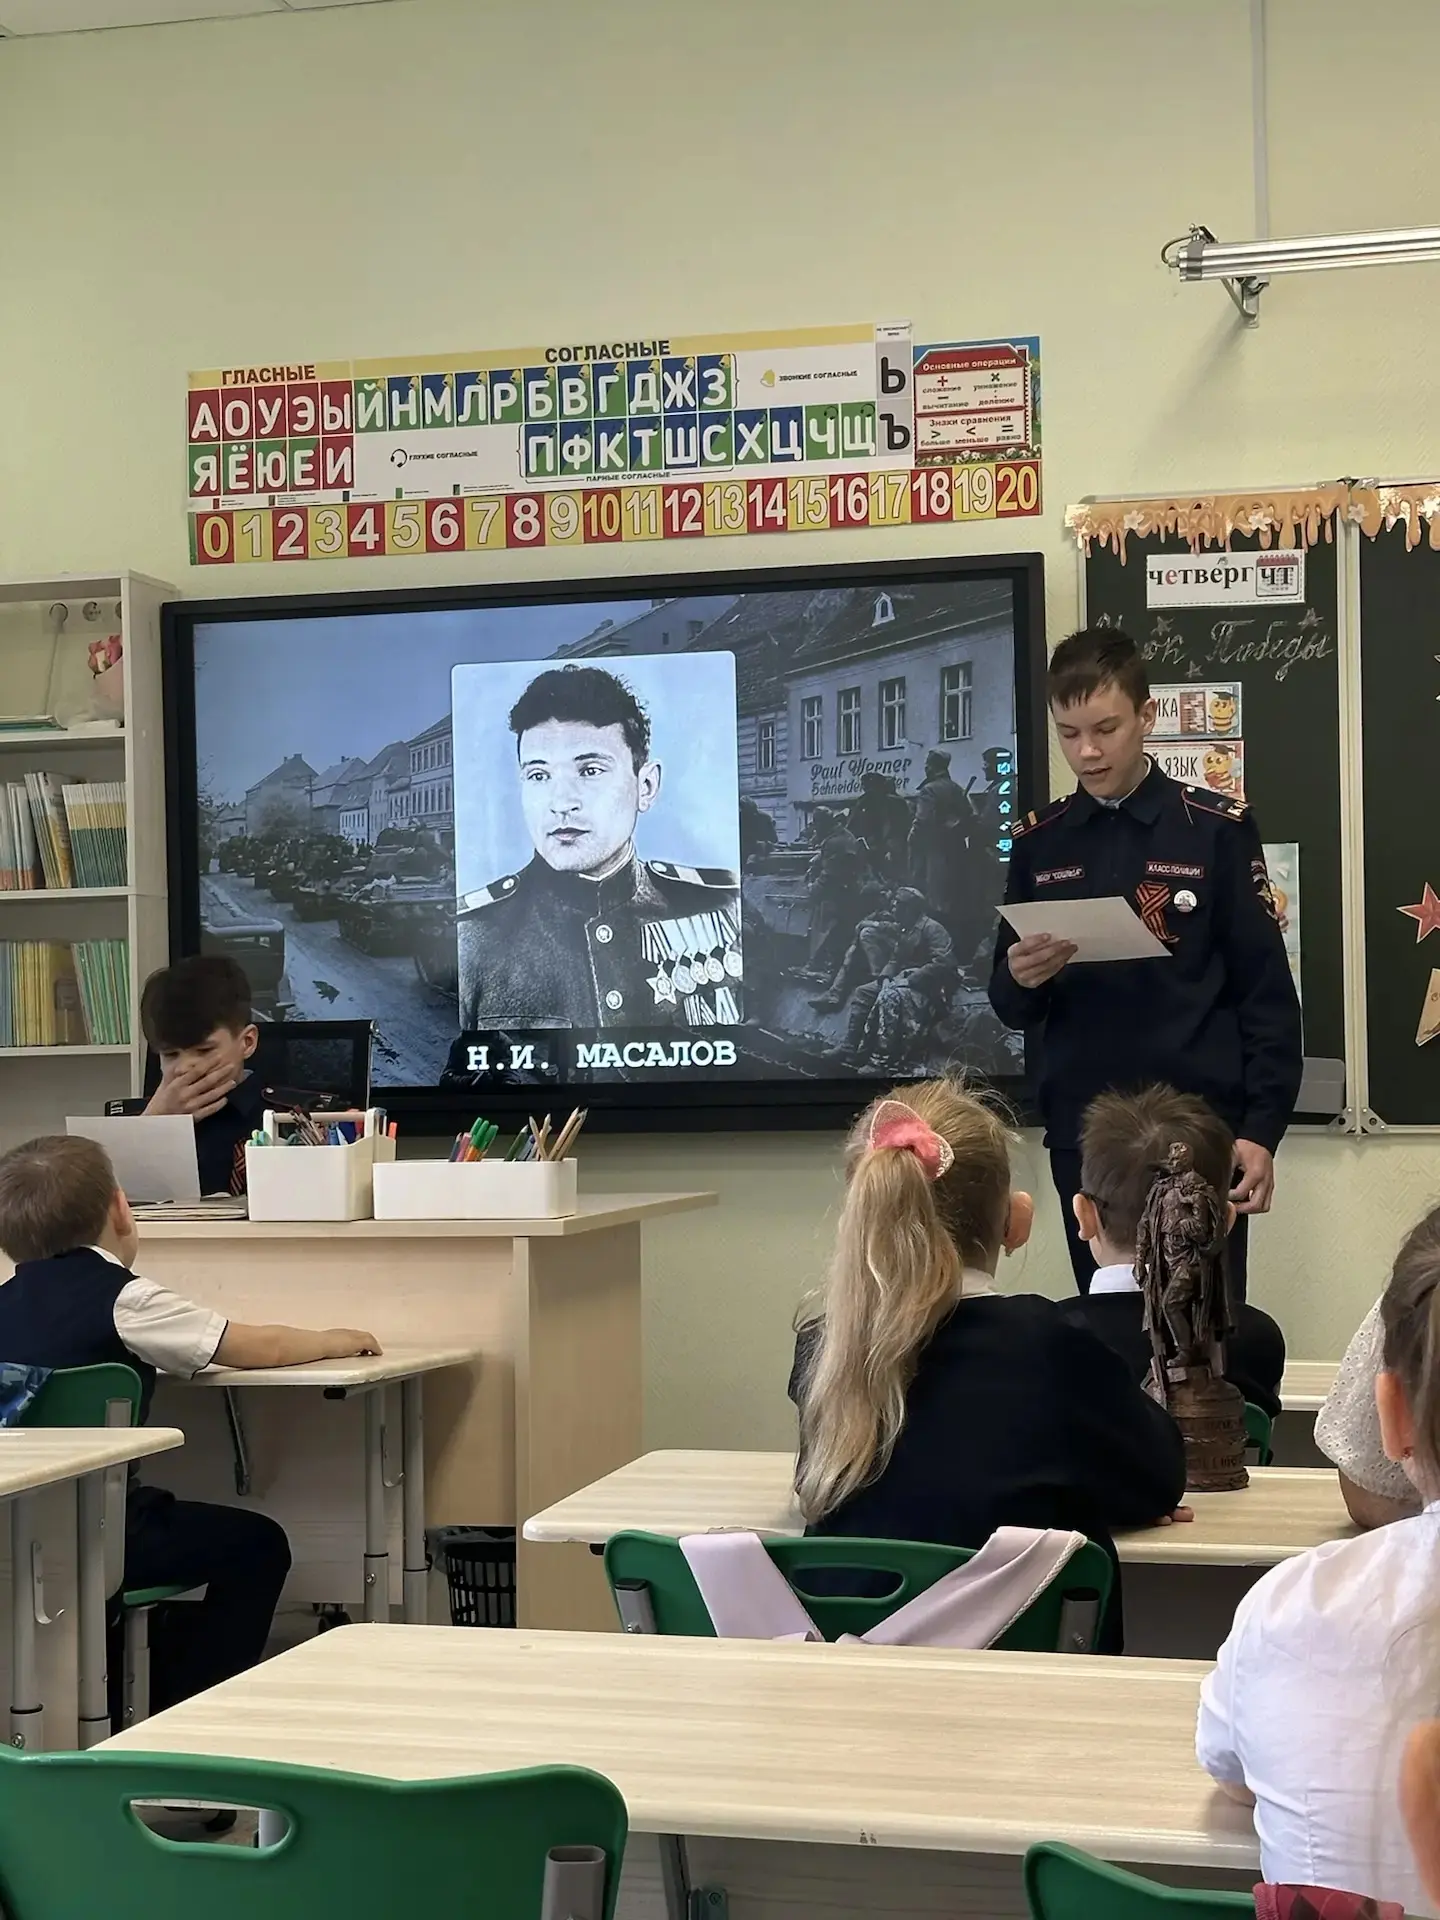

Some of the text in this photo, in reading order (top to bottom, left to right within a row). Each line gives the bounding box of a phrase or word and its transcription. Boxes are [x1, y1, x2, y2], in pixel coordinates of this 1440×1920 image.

[545, 340, 671, 363] СОГЛАСНЫЕ
[922, 358, 1016, 371] Основные операции
[222, 365, 316, 385] ГЛАСНЫЕ
[779, 370, 858, 382] ЗВОНКИЕ СОГЛАСНЫЕ
[929, 415, 1011, 427] Знаки сравнения
[996, 434, 1021, 442] равно
[436, 451, 478, 459] СОГЛАСНЫЕ
[586, 471, 671, 482] ПАРНЫЕ СОГЛАСНЫЕ
[241, 514, 262, 558] 1
[277, 513, 305, 556] 2
[314, 510, 344, 553] 3
[350, 508, 379, 550] 4
[391, 505, 421, 548] 5
[431, 502, 460, 546] 6
[471, 501, 500, 544] 7
[512, 498, 541, 541] 8
[550, 495, 579, 539] 9
[584, 493, 621, 537] 10
[625, 489, 656, 535] 11
[664, 488, 702, 532] 12
[706, 484, 745, 530] 13
[748, 482, 787, 527] 14
[789, 479, 828, 524] 15
[830, 476, 868, 522] 16
[869, 474, 909, 519] 17
[912, 471, 951, 516] 18
[954, 467, 994, 513] 19
[996, 465, 1038, 512] 20
[1149, 567, 1254, 589] четверг
[1205, 620, 1333, 681] Победы
[810, 760, 846, 781] Paul
[466, 1040, 737, 1071] Н.И. МАСАЛОВ
